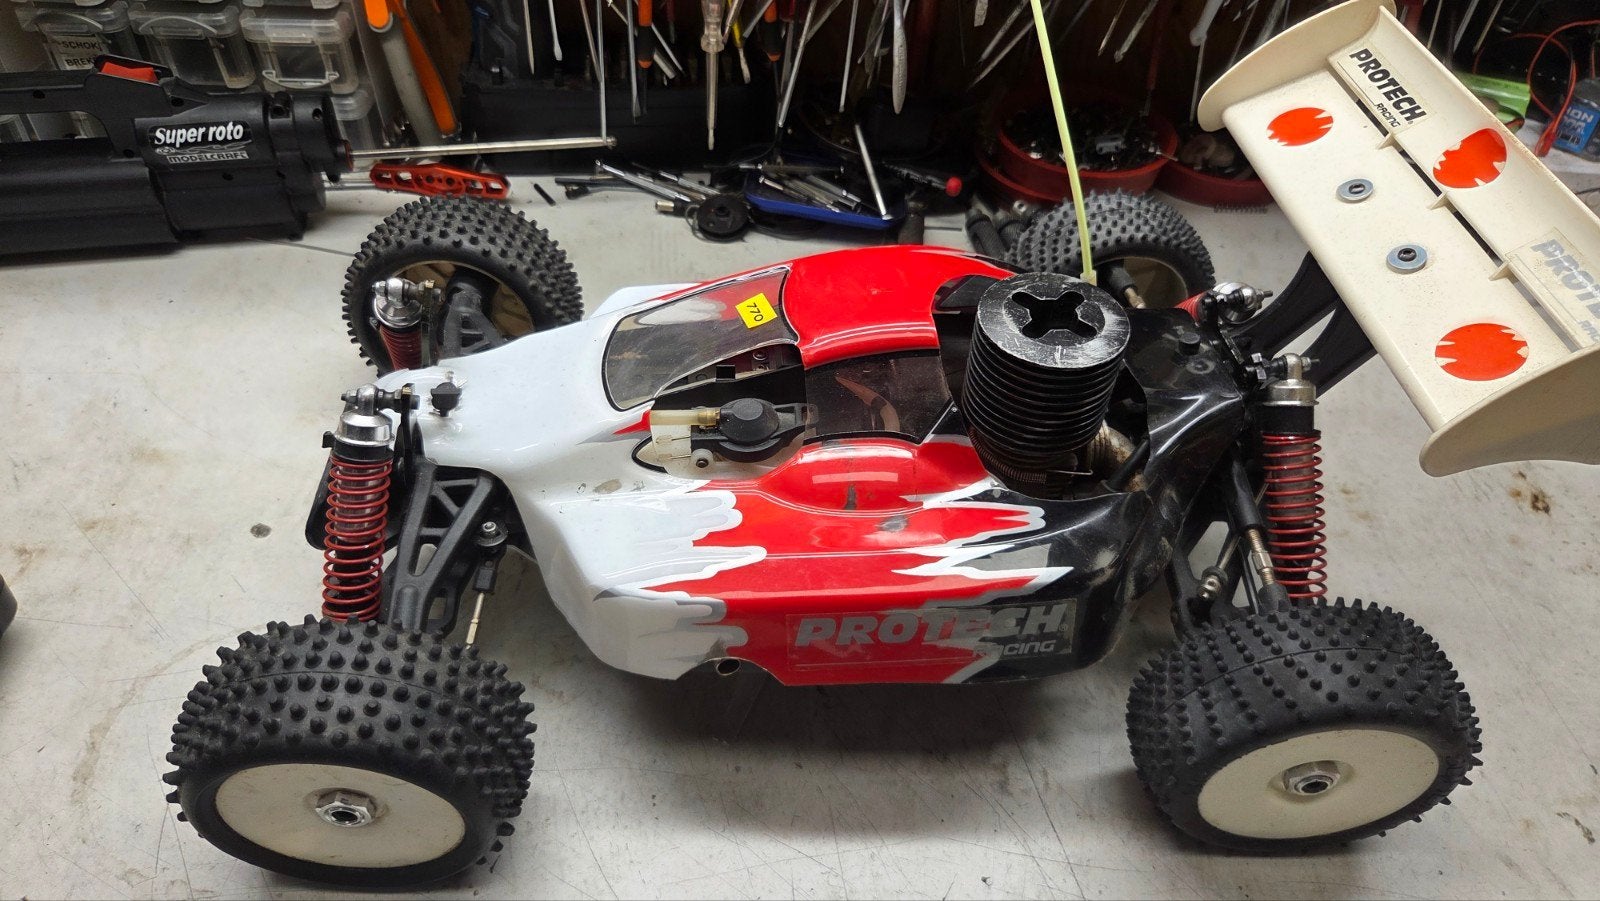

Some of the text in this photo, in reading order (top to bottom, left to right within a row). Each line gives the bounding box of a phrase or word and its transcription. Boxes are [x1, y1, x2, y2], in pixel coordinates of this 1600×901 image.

[1349, 48, 1427, 122] PROTECH
[154, 121, 244, 148] Super roto
[746, 302, 764, 322] 770
[795, 603, 1068, 647] PROTECH
